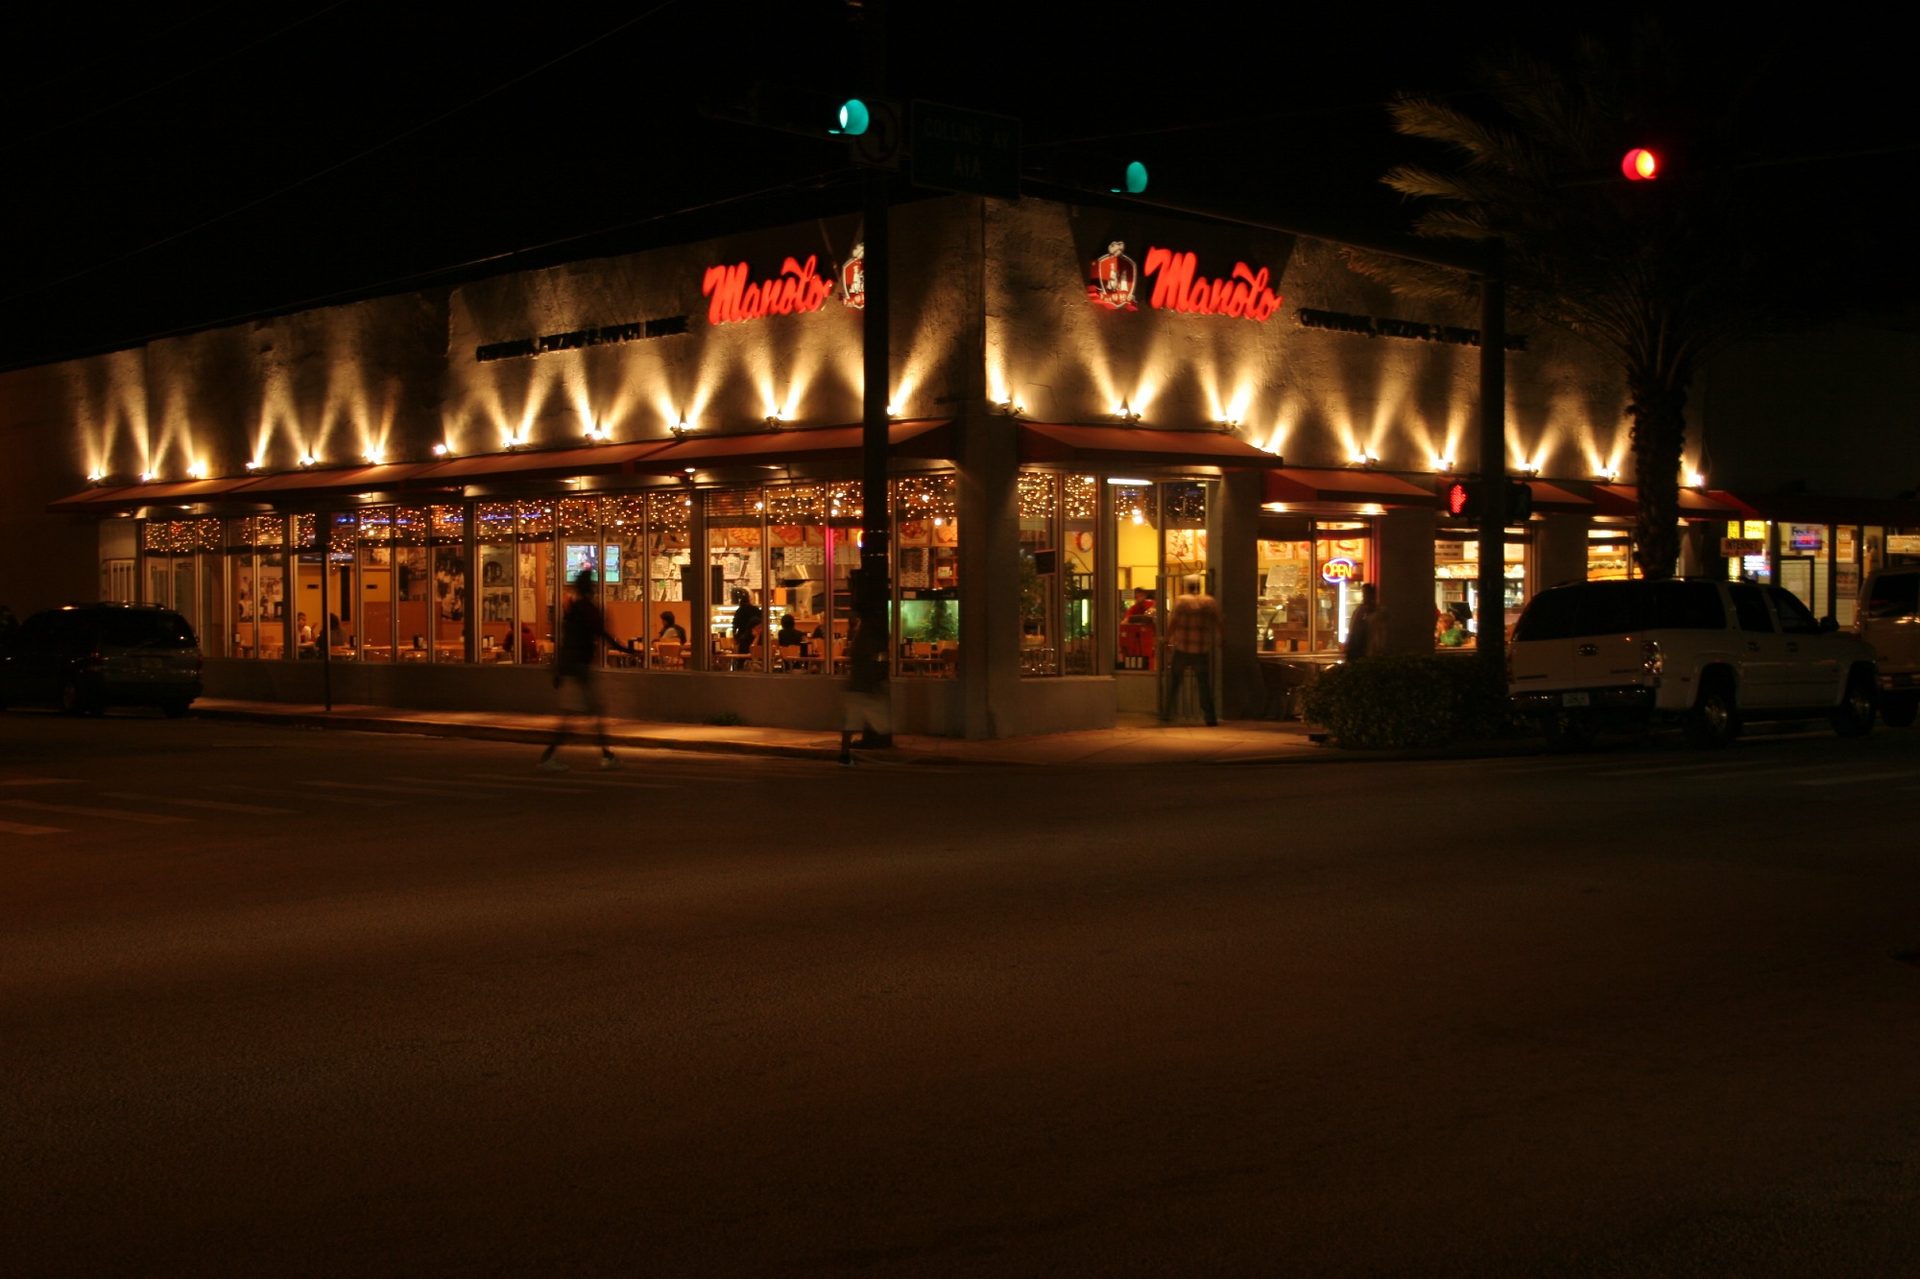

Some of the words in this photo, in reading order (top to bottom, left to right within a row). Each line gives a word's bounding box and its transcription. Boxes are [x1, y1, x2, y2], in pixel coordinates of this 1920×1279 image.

[921, 118, 983, 144] COLLINS
[702, 253, 834, 326] Manolo
[1144, 245, 1283, 322] Manolo
[1322, 562, 1352, 578] OPEN
